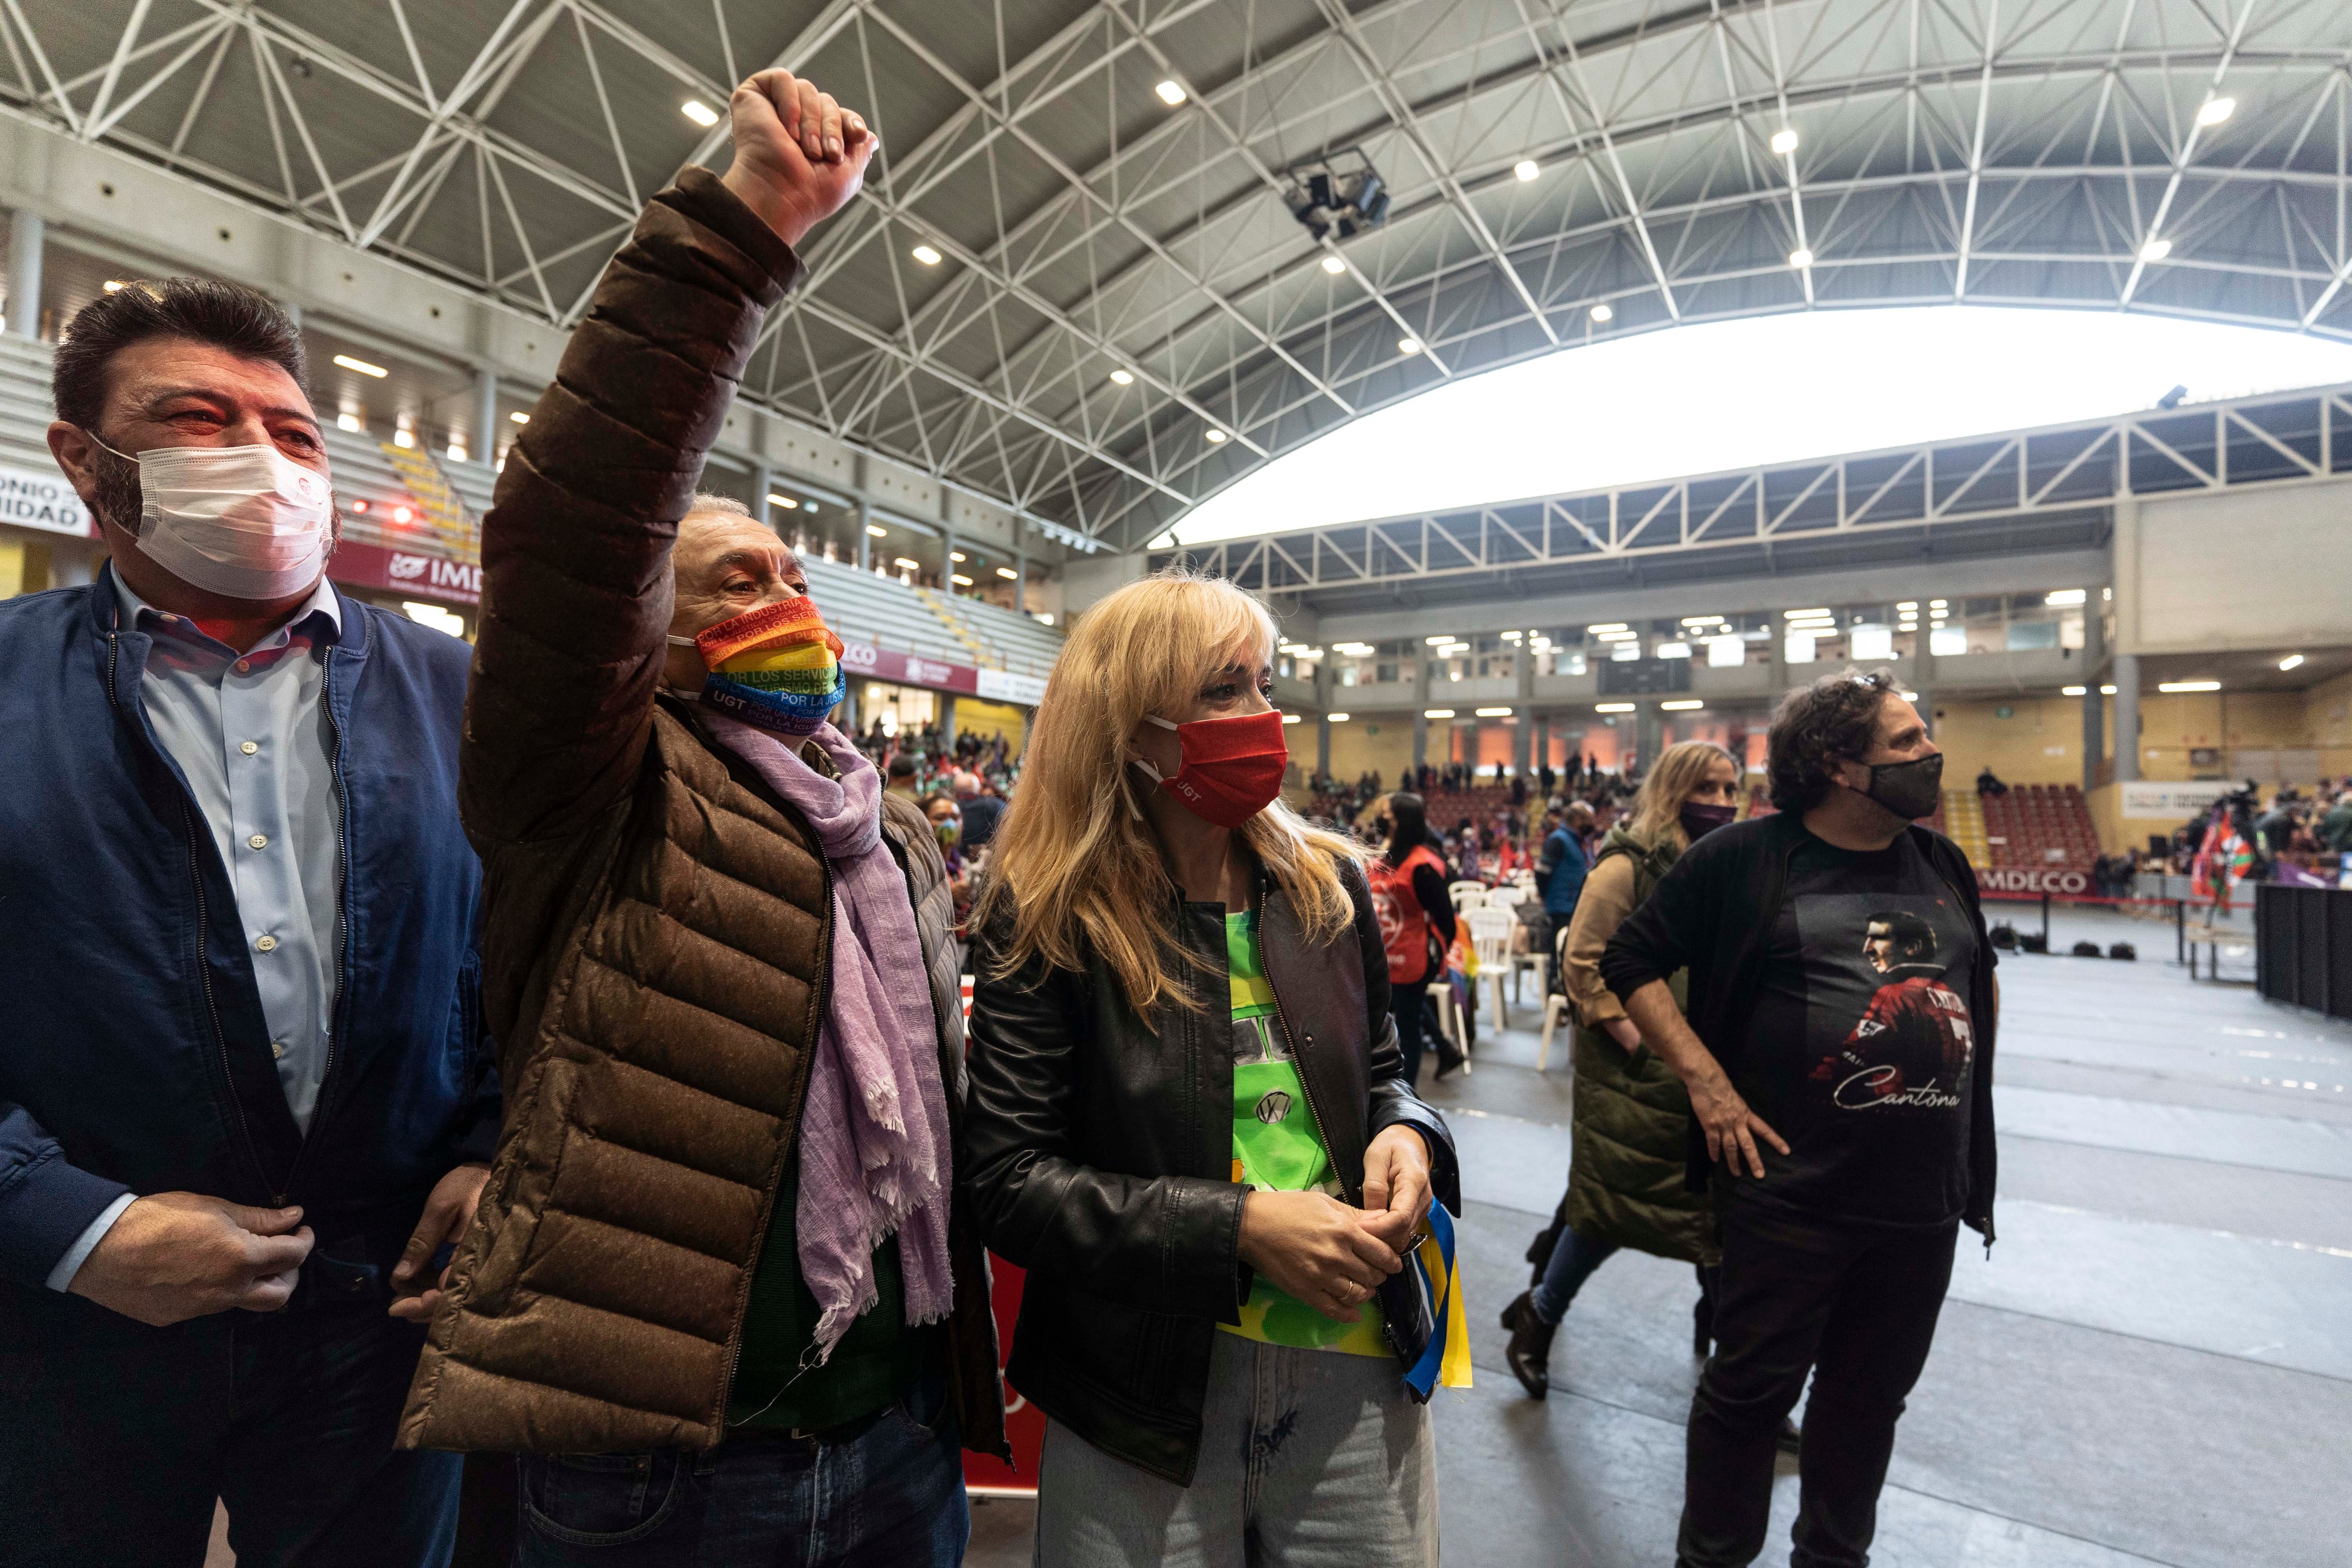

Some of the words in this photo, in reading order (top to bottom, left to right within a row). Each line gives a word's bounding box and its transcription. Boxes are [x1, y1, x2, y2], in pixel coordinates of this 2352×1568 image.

[697, 626, 722, 644] POR
[723, 619, 739, 631] LA
[741, 598, 803, 624] INDUSTRIA
[700, 639, 717, 650] POR
[731, 619, 767, 636] JUSTICIA
[768, 609, 798, 621] SOCIAL
[737, 627, 763, 642] POR
[765, 618, 790, 630] LOS
[709, 650, 728, 662] POR
[728, 643, 742, 652] UN
[742, 630, 779, 646] PLANETA
[752, 670, 780, 683] LOS
[714, 691, 747, 710] UGT
[781, 692, 807, 706] POR
[810, 697, 823, 706] LA
[1177, 781, 1201, 802] UGT
[1834, 1064, 1961, 1109] Cantona
